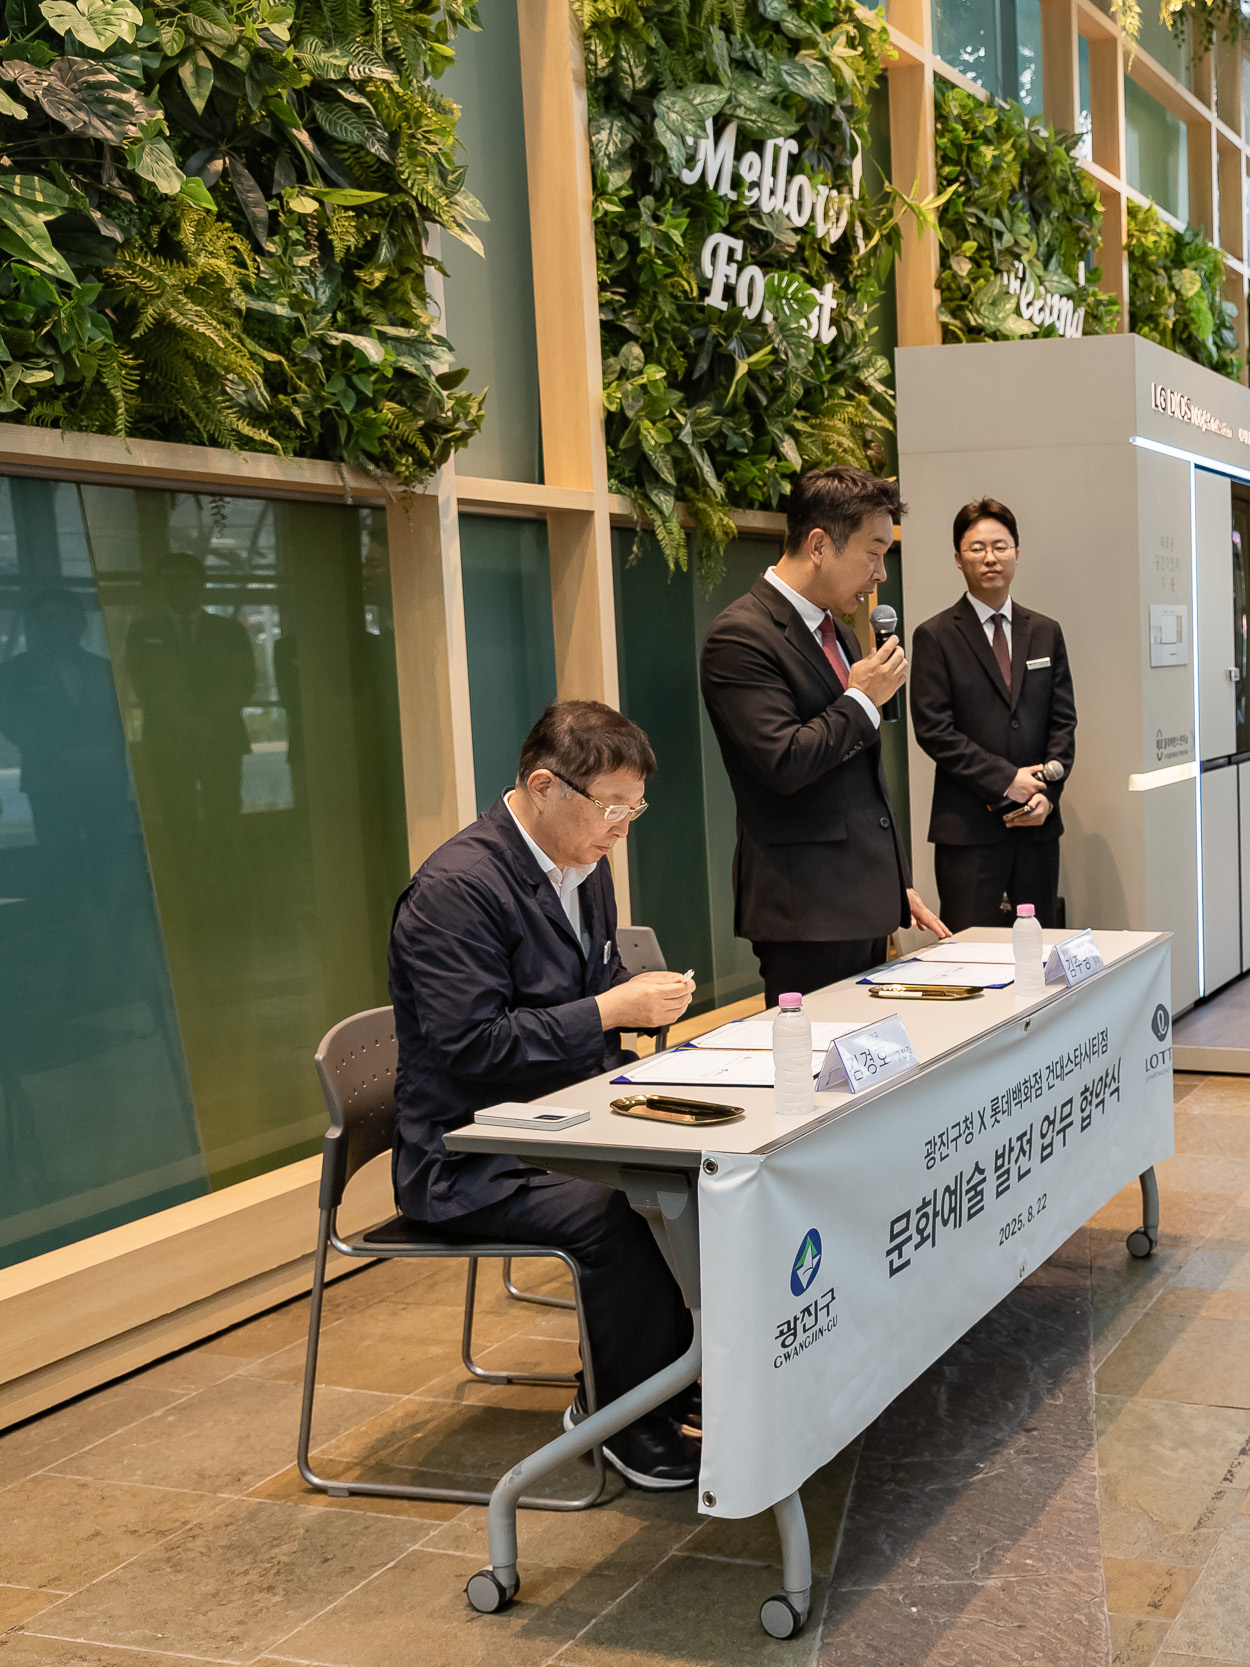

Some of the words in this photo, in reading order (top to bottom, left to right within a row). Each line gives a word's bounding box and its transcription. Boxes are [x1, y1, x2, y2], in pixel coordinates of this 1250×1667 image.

[681, 117, 849, 244] Mellow
[701, 232, 838, 345] Fost
[1151, 382, 1167, 413] LG
[1167, 388, 1192, 423] DIOS
[1145, 1047, 1172, 1073] LOTT
[924, 1111, 974, 1170] 광진구청
[977, 1106, 987, 1135] X
[990, 1068, 1043, 1128] 롯데백화점
[1045, 1027, 1109, 1091] 건대스타시티점
[885, 1160, 987, 1278] 문화예술
[994, 1122, 1034, 1200] 발전
[1040, 1096, 1074, 1164] 업무
[1079, 1057, 1121, 1133] 협약식
[998, 1213, 1025, 1247] 2025.
[1027, 1205, 1036, 1224] 8.
[1037, 1193, 1047, 1212] 22
[773, 1314, 838, 1369] GWANGJIN-GU
[774, 1287, 836, 1349] 광진구
